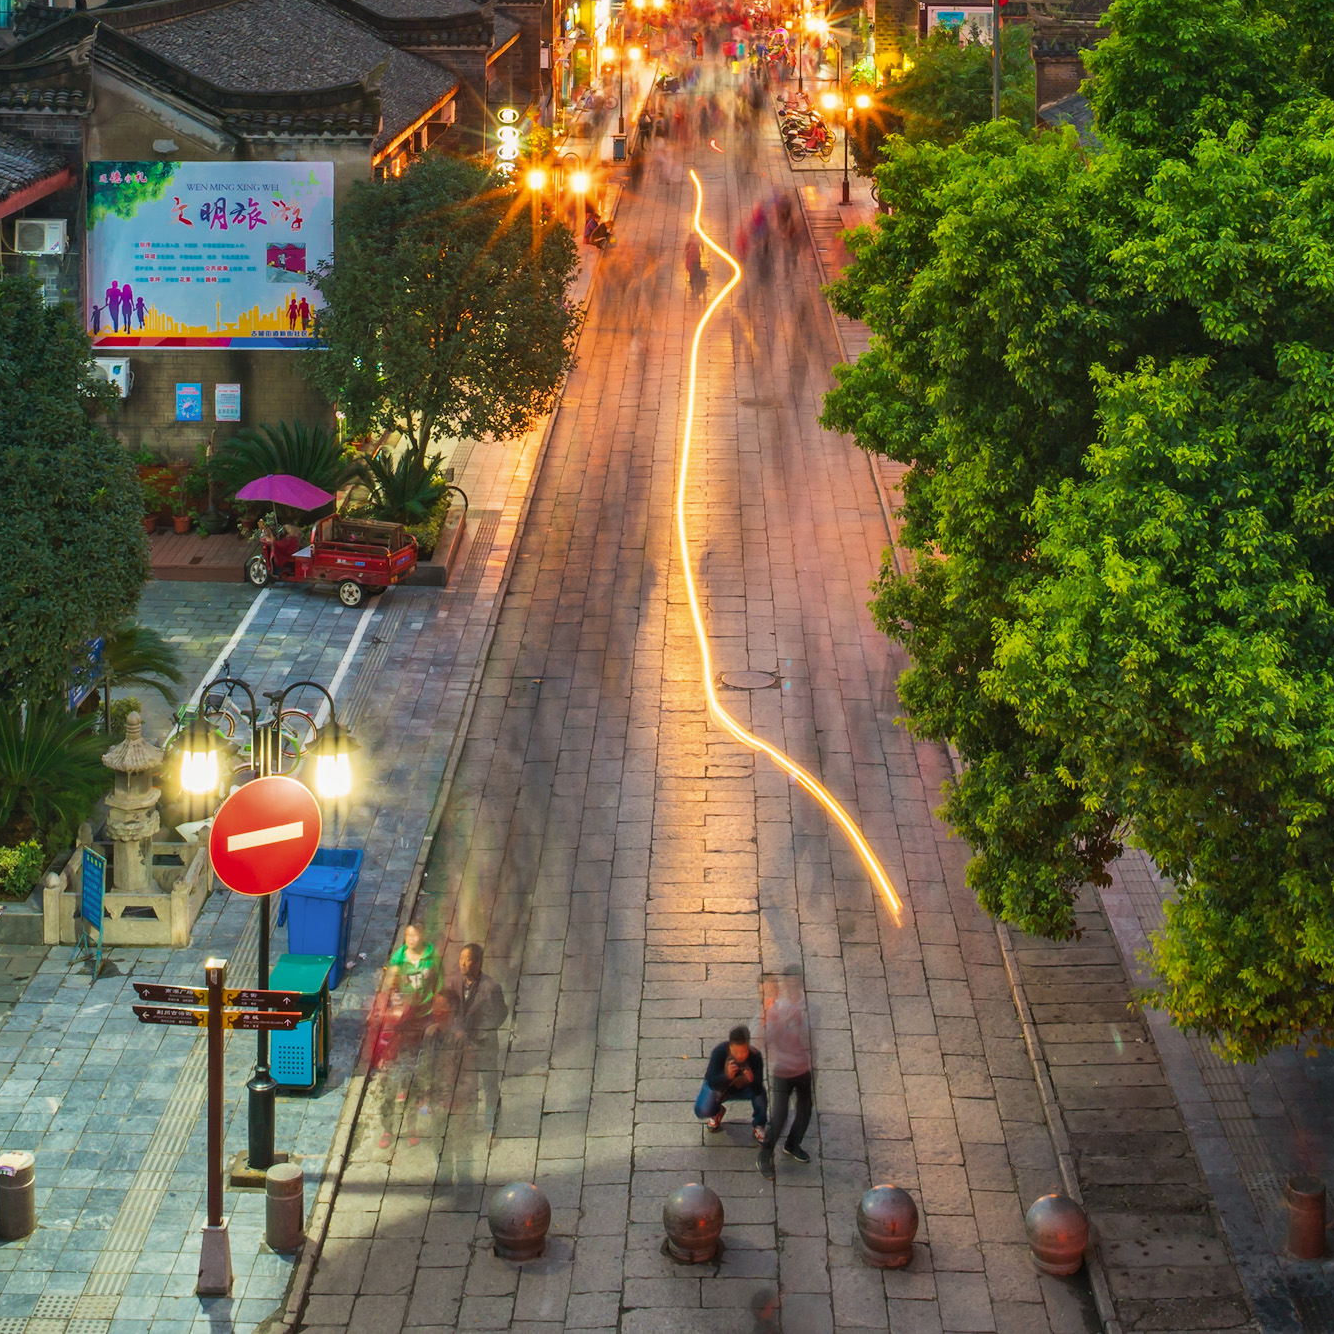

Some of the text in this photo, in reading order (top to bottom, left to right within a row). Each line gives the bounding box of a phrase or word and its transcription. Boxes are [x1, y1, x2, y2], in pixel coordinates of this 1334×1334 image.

[187, 183, 279, 192] WEN MING XING WEI
[170, 196, 304, 232] 文明旅游
